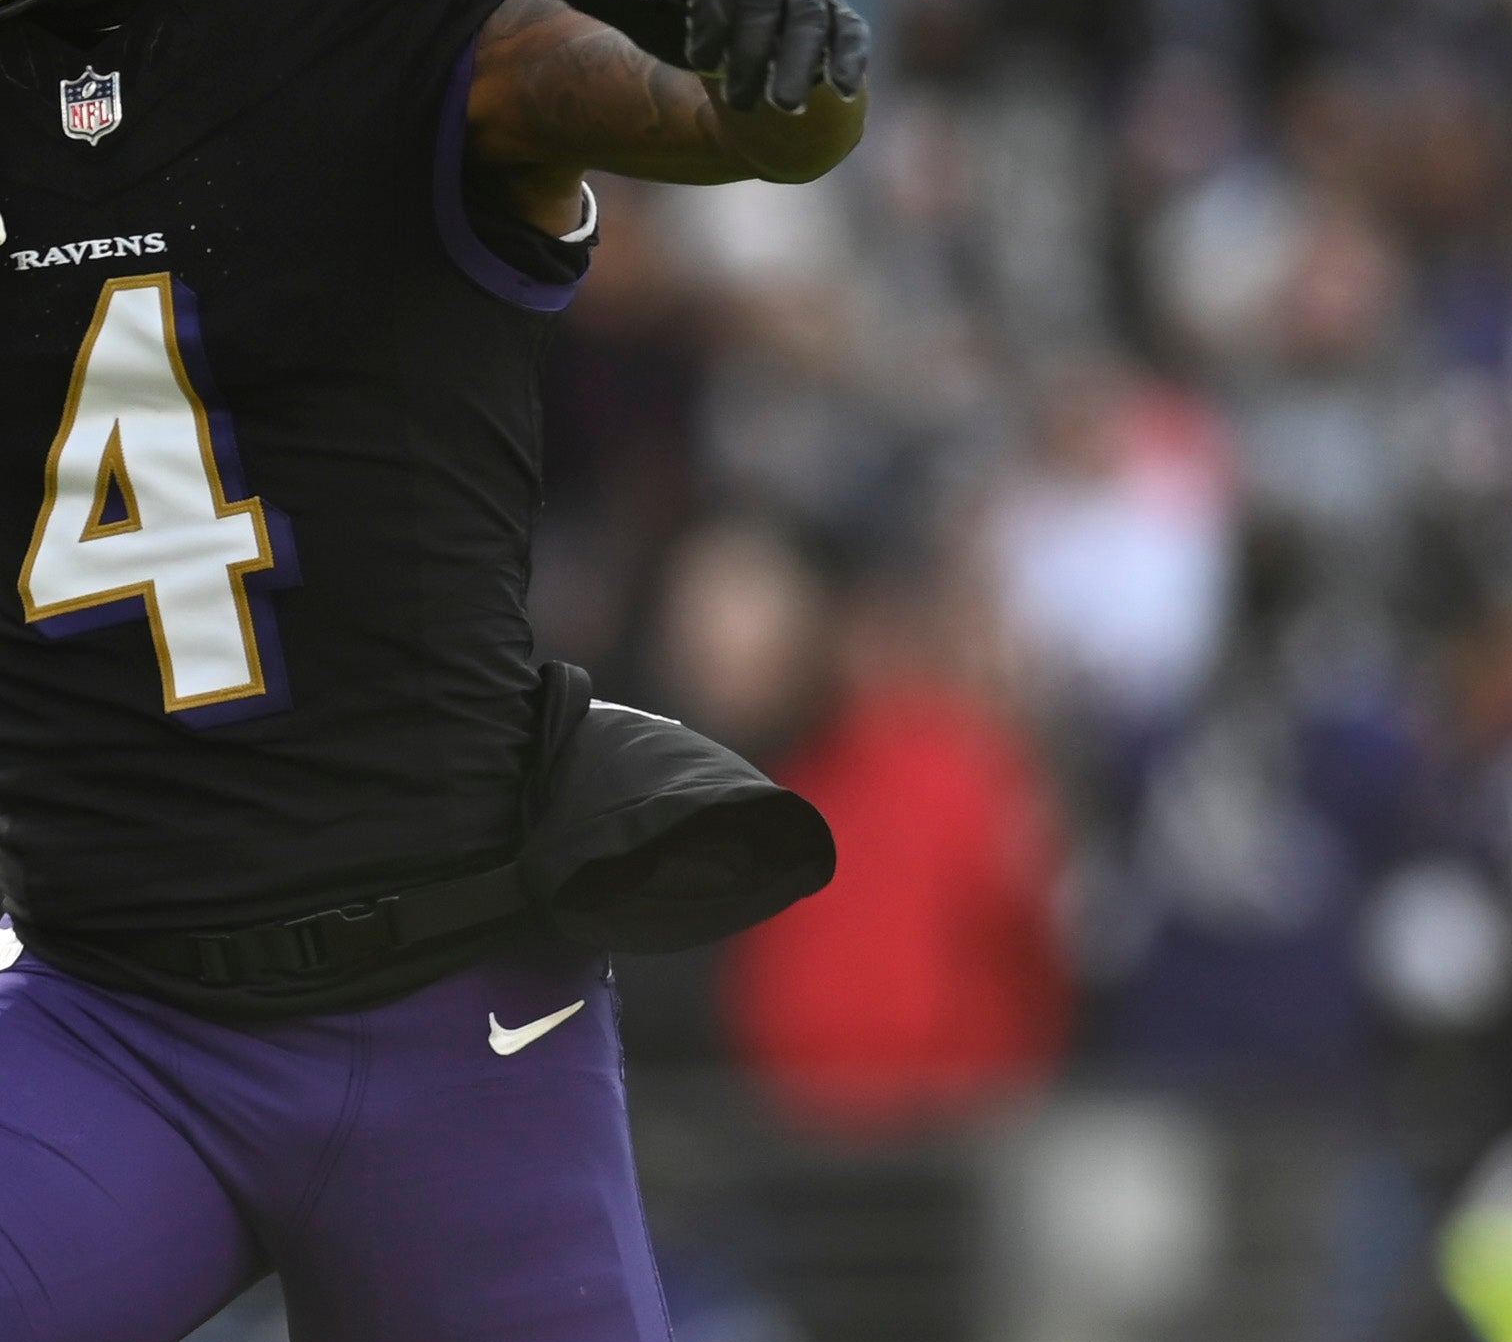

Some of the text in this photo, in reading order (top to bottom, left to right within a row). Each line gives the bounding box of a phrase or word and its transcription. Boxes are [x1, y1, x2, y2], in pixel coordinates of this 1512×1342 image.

[71, 100, 110, 130] NFL
[10, 232, 167, 271] RAVENS
[17, 272, 274, 714] 4
